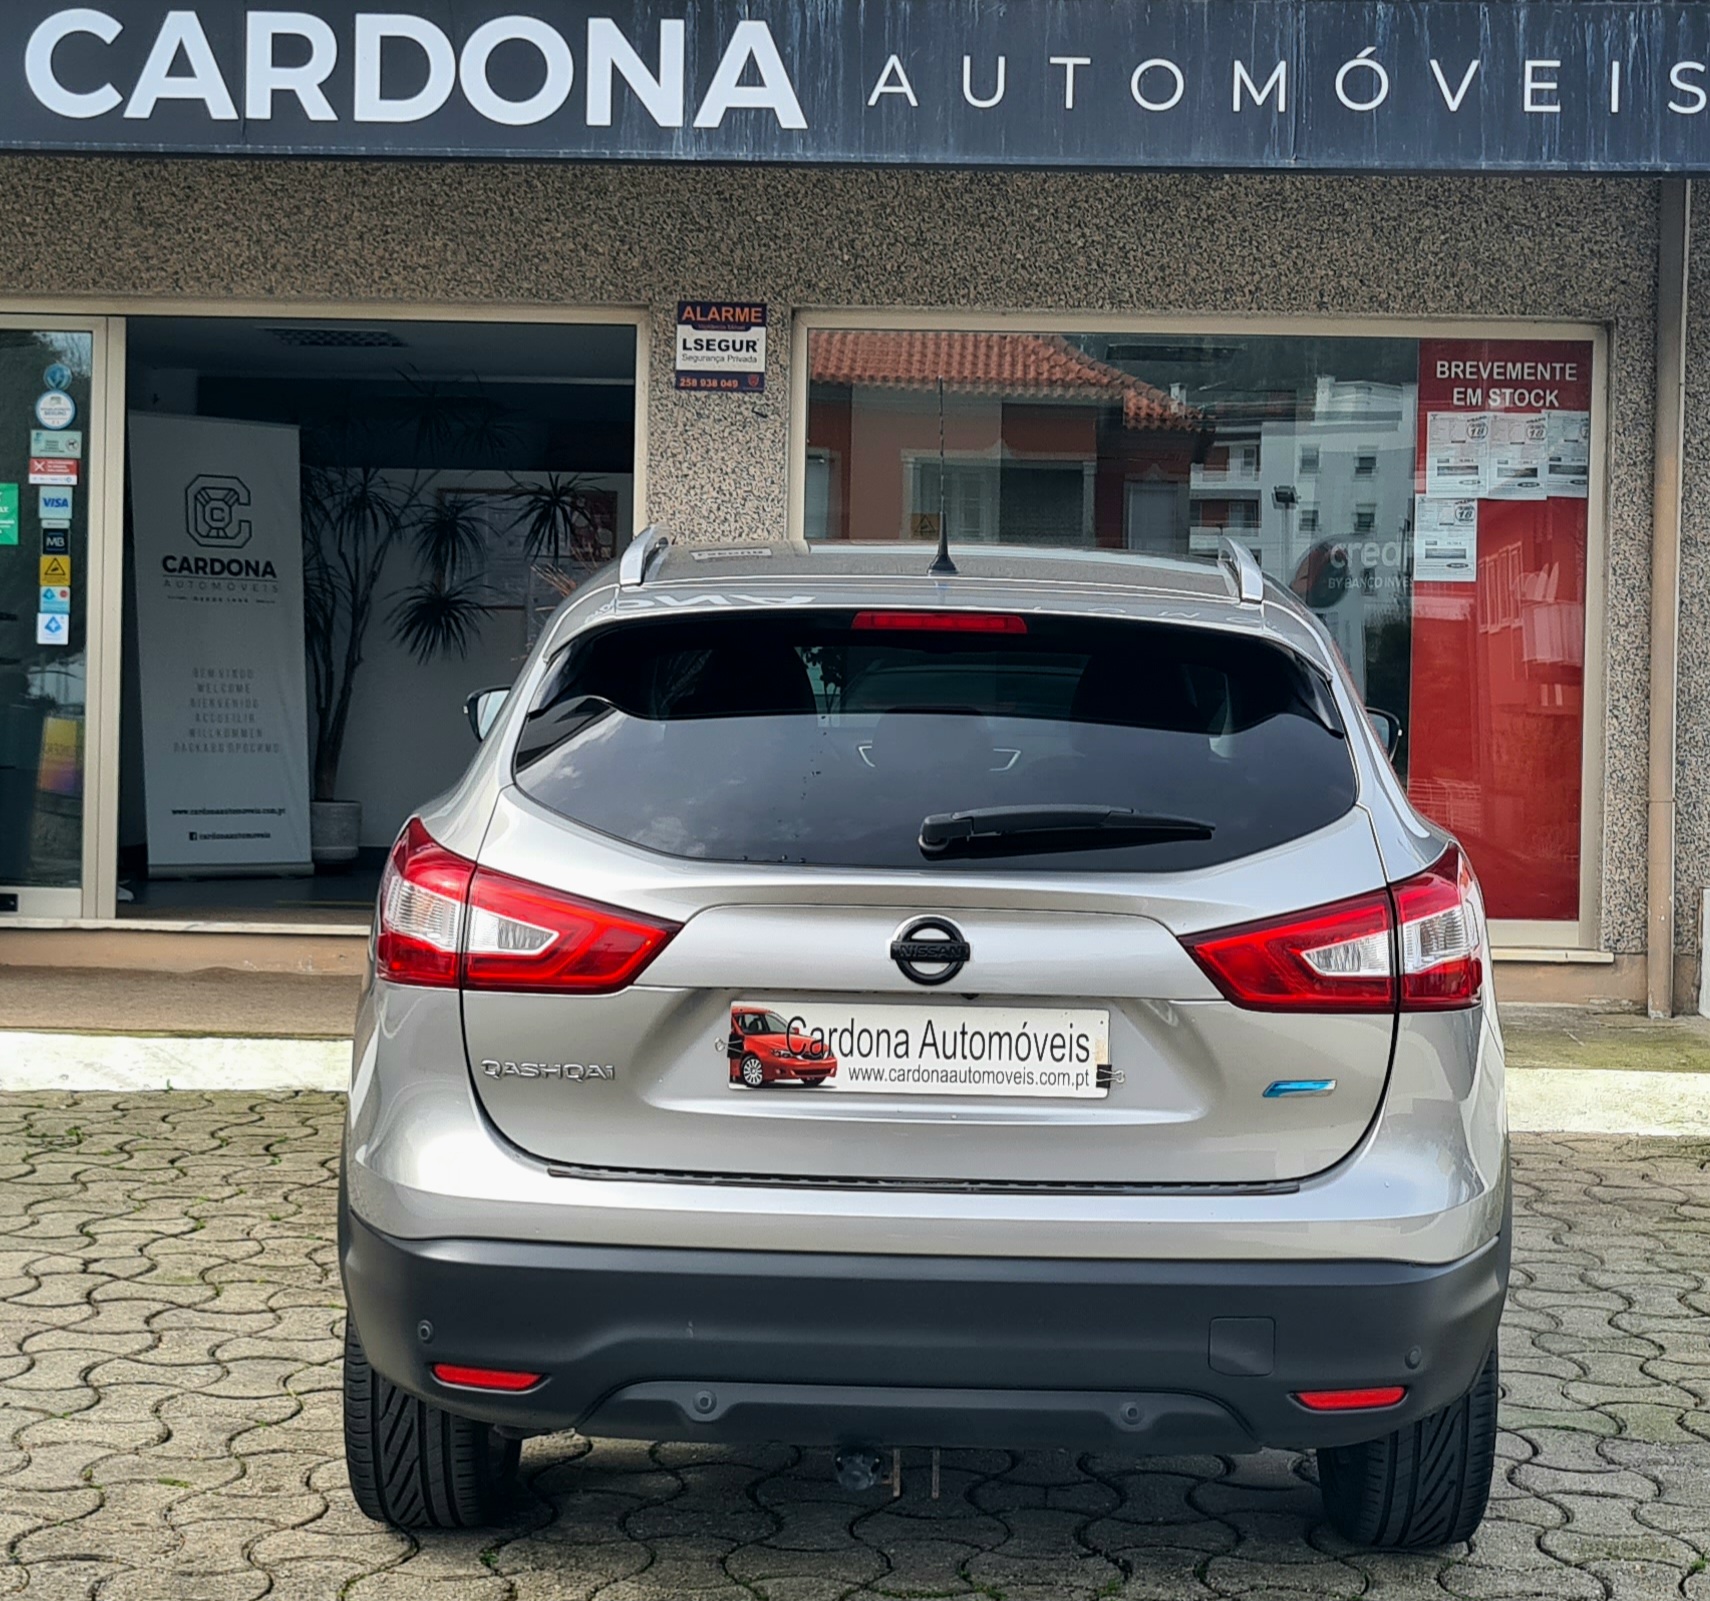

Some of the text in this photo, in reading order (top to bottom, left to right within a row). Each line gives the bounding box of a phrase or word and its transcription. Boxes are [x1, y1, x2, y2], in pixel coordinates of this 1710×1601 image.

[24, 8, 1708, 129] CARDONA AUTOMÓVEIS
[681, 305, 763, 323] ALARME
[682, 338, 757, 353] LSEGUR
[681, 353, 757, 364] Segurança Privada
[1436, 360, 1577, 381] BREVEMENTE
[1453, 387, 1560, 407] EM STOCK
[42, 497, 69, 508] VISA
[46, 536, 66, 548] MB
[162, 555, 277, 579] CARDONA
[1328, 577, 1344, 589] BY
[1345, 576, 1383, 589] BANCO
[197, 683, 251, 694] WELCOME
[899, 944, 963, 958] NISSAN
[785, 1015, 1091, 1063] Cardona Automóveis
[481, 1059, 615, 1083] QASHQAI
[848, 1065, 1090, 1091] www.cardonaautomoveis.com.pt
